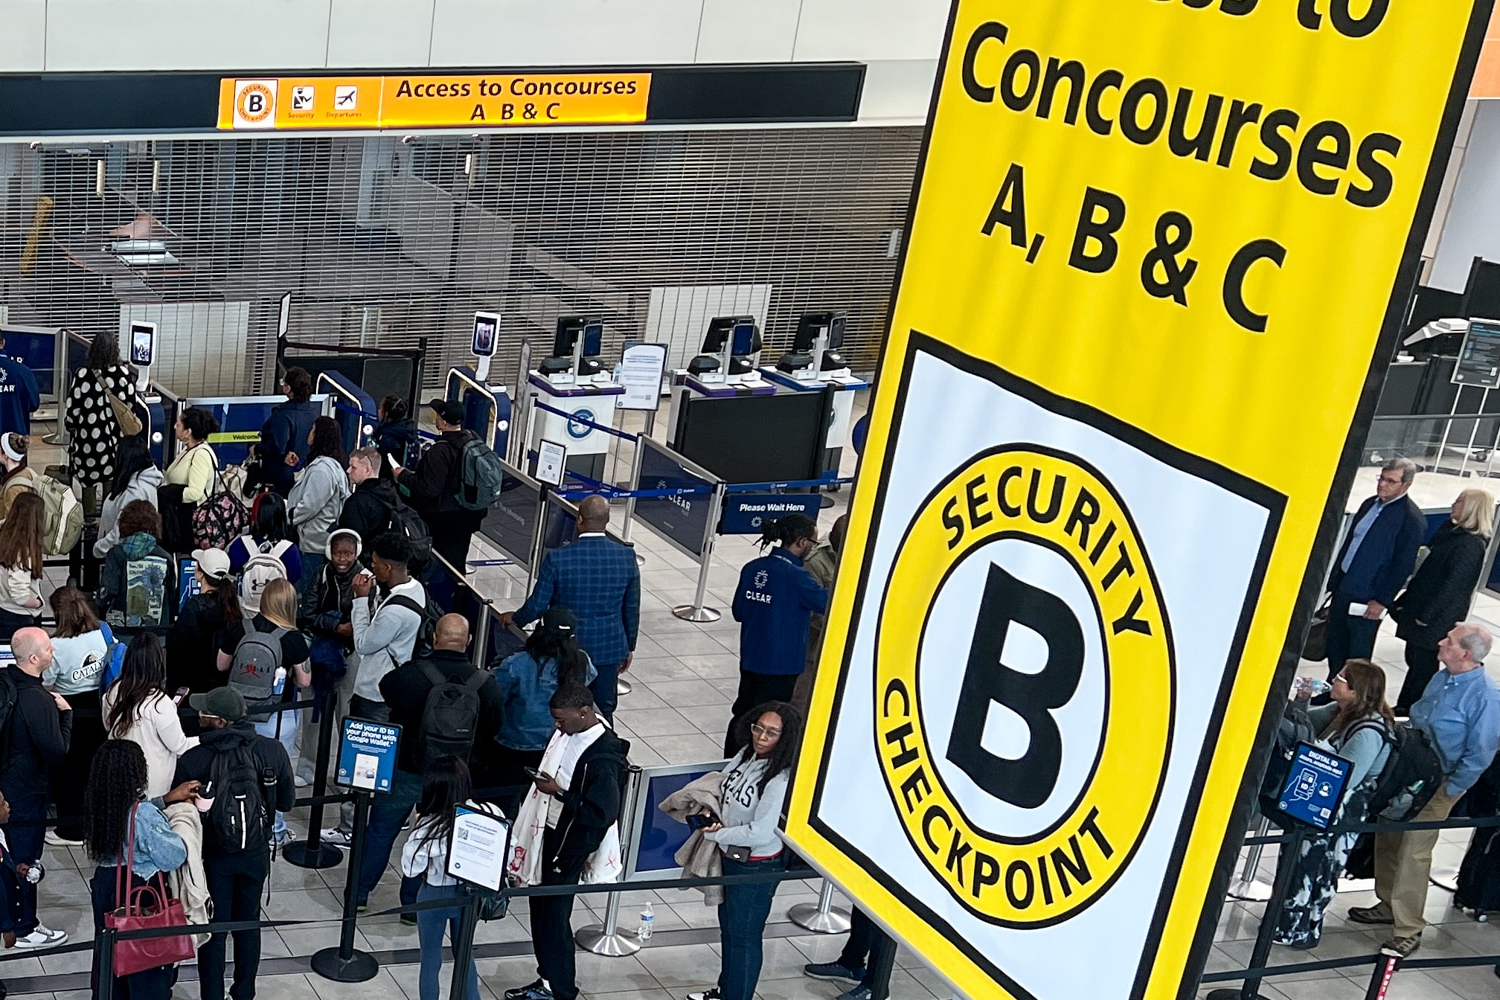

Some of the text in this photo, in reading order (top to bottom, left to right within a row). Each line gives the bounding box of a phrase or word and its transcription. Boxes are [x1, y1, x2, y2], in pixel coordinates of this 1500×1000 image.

[243, 84, 269, 95] SECURITY
[396, 78, 636, 98] Access to Concourses
[249, 95, 263, 112] B
[470, 103, 560, 121] A B & C
[239, 107, 270, 122] CHECKPOINT
[961, 21, 1402, 208] Concourses
[981, 162, 1287, 333] A, B & C
[740, 503, 805, 512] Please Wait Here
[941, 465, 1153, 639] SECURITY
[746, 590, 772, 604] CLEAR
[946, 562, 1086, 809] B
[349, 722, 363, 730] Add
[364, 724, 378, 732] your
[361, 731, 381, 739] phone
[347, 734, 369, 743] Google
[882, 678, 1117, 908] CHECKPOINT
